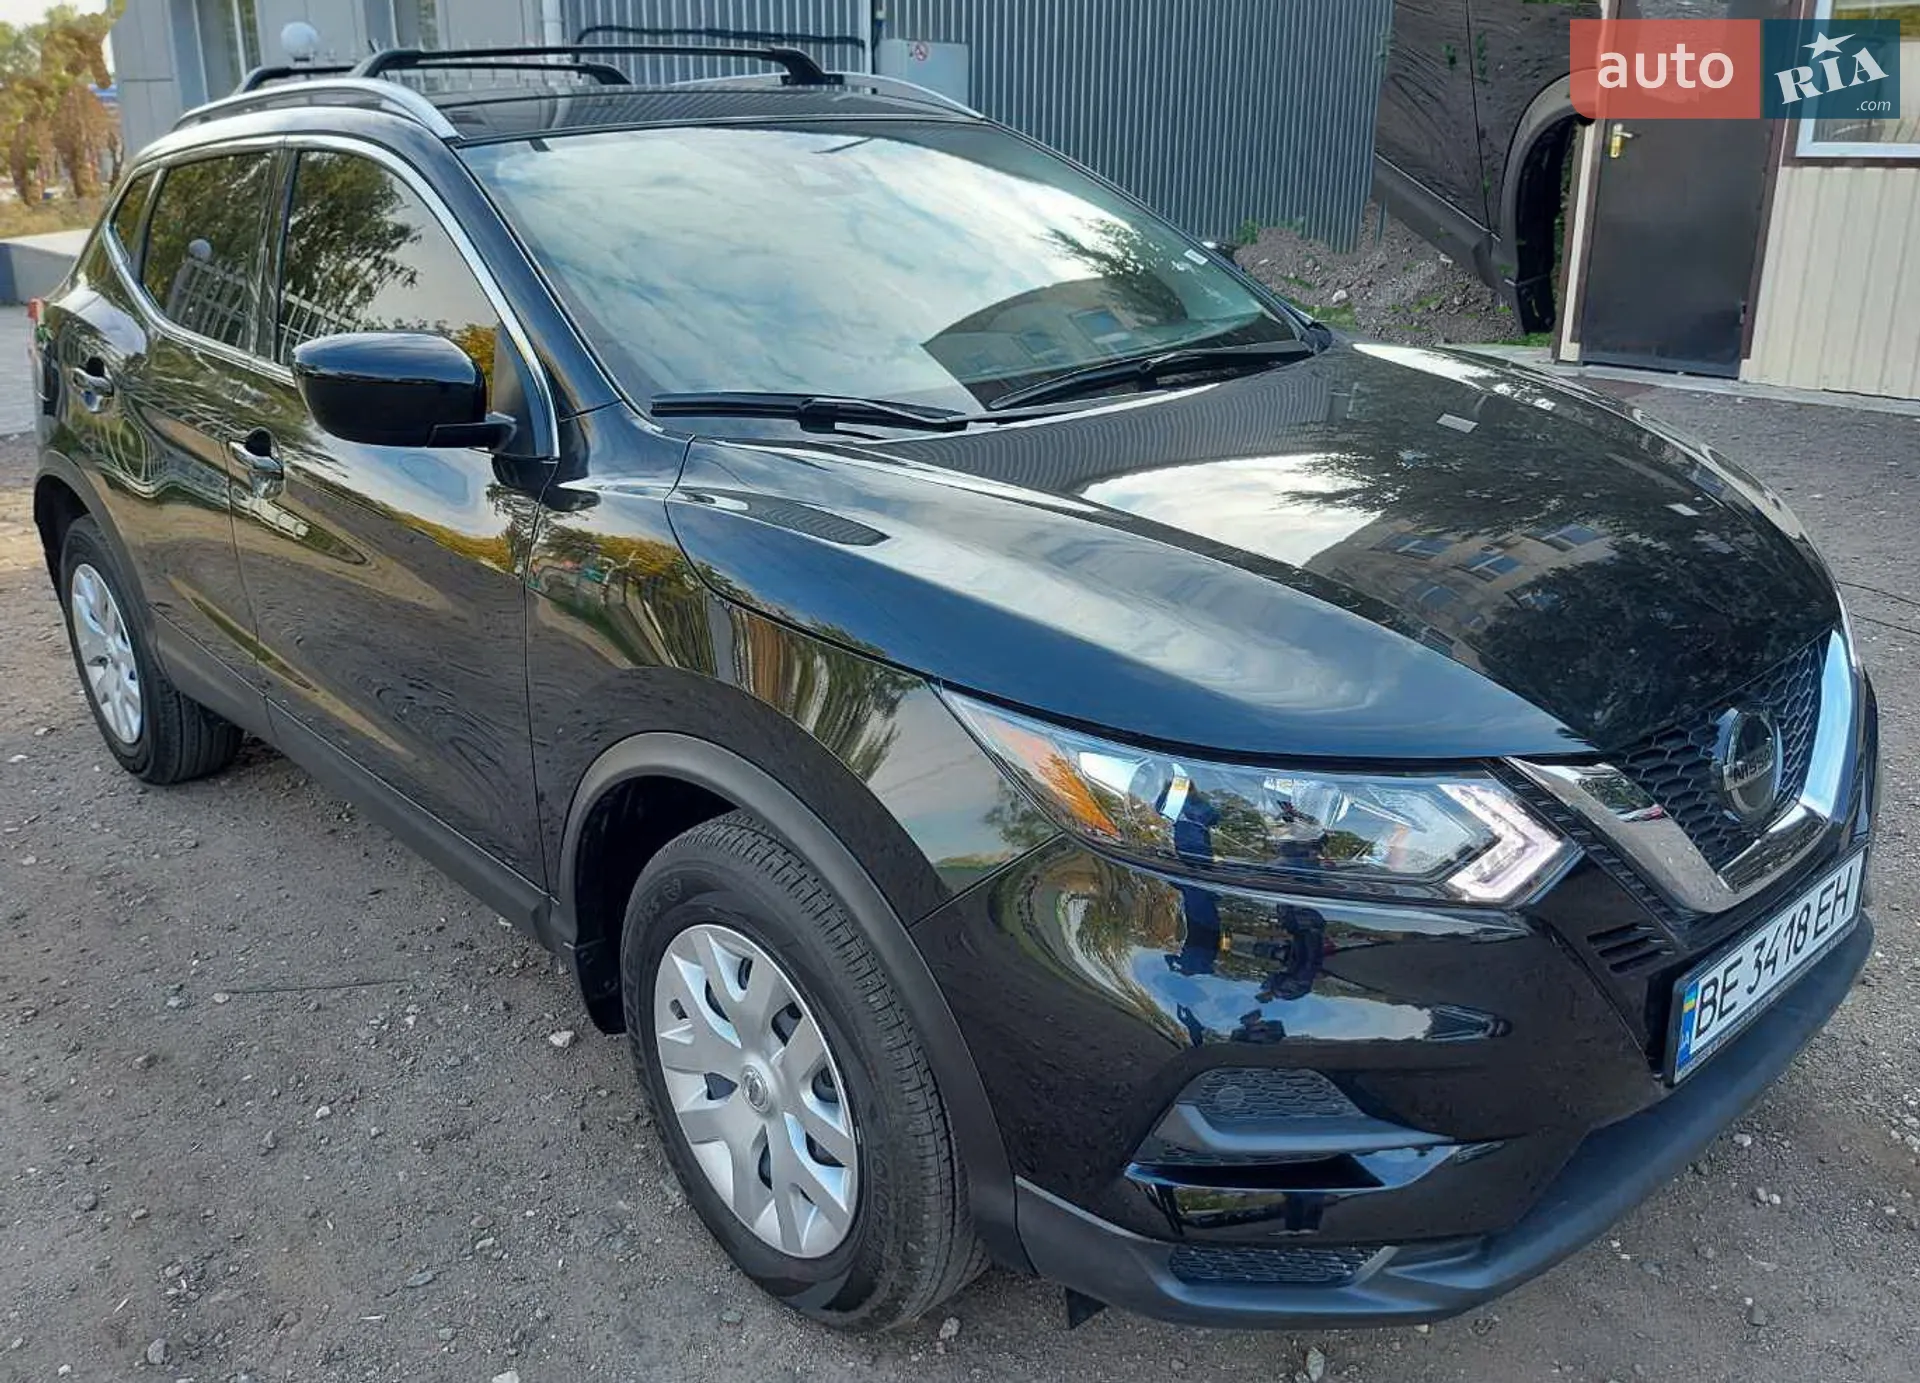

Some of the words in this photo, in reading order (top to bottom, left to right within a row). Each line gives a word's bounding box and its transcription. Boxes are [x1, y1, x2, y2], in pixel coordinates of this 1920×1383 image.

[1694, 956, 1743, 1040] BE
[1746, 902, 1811, 995] 3418
[1813, 866, 1853, 941] EH
